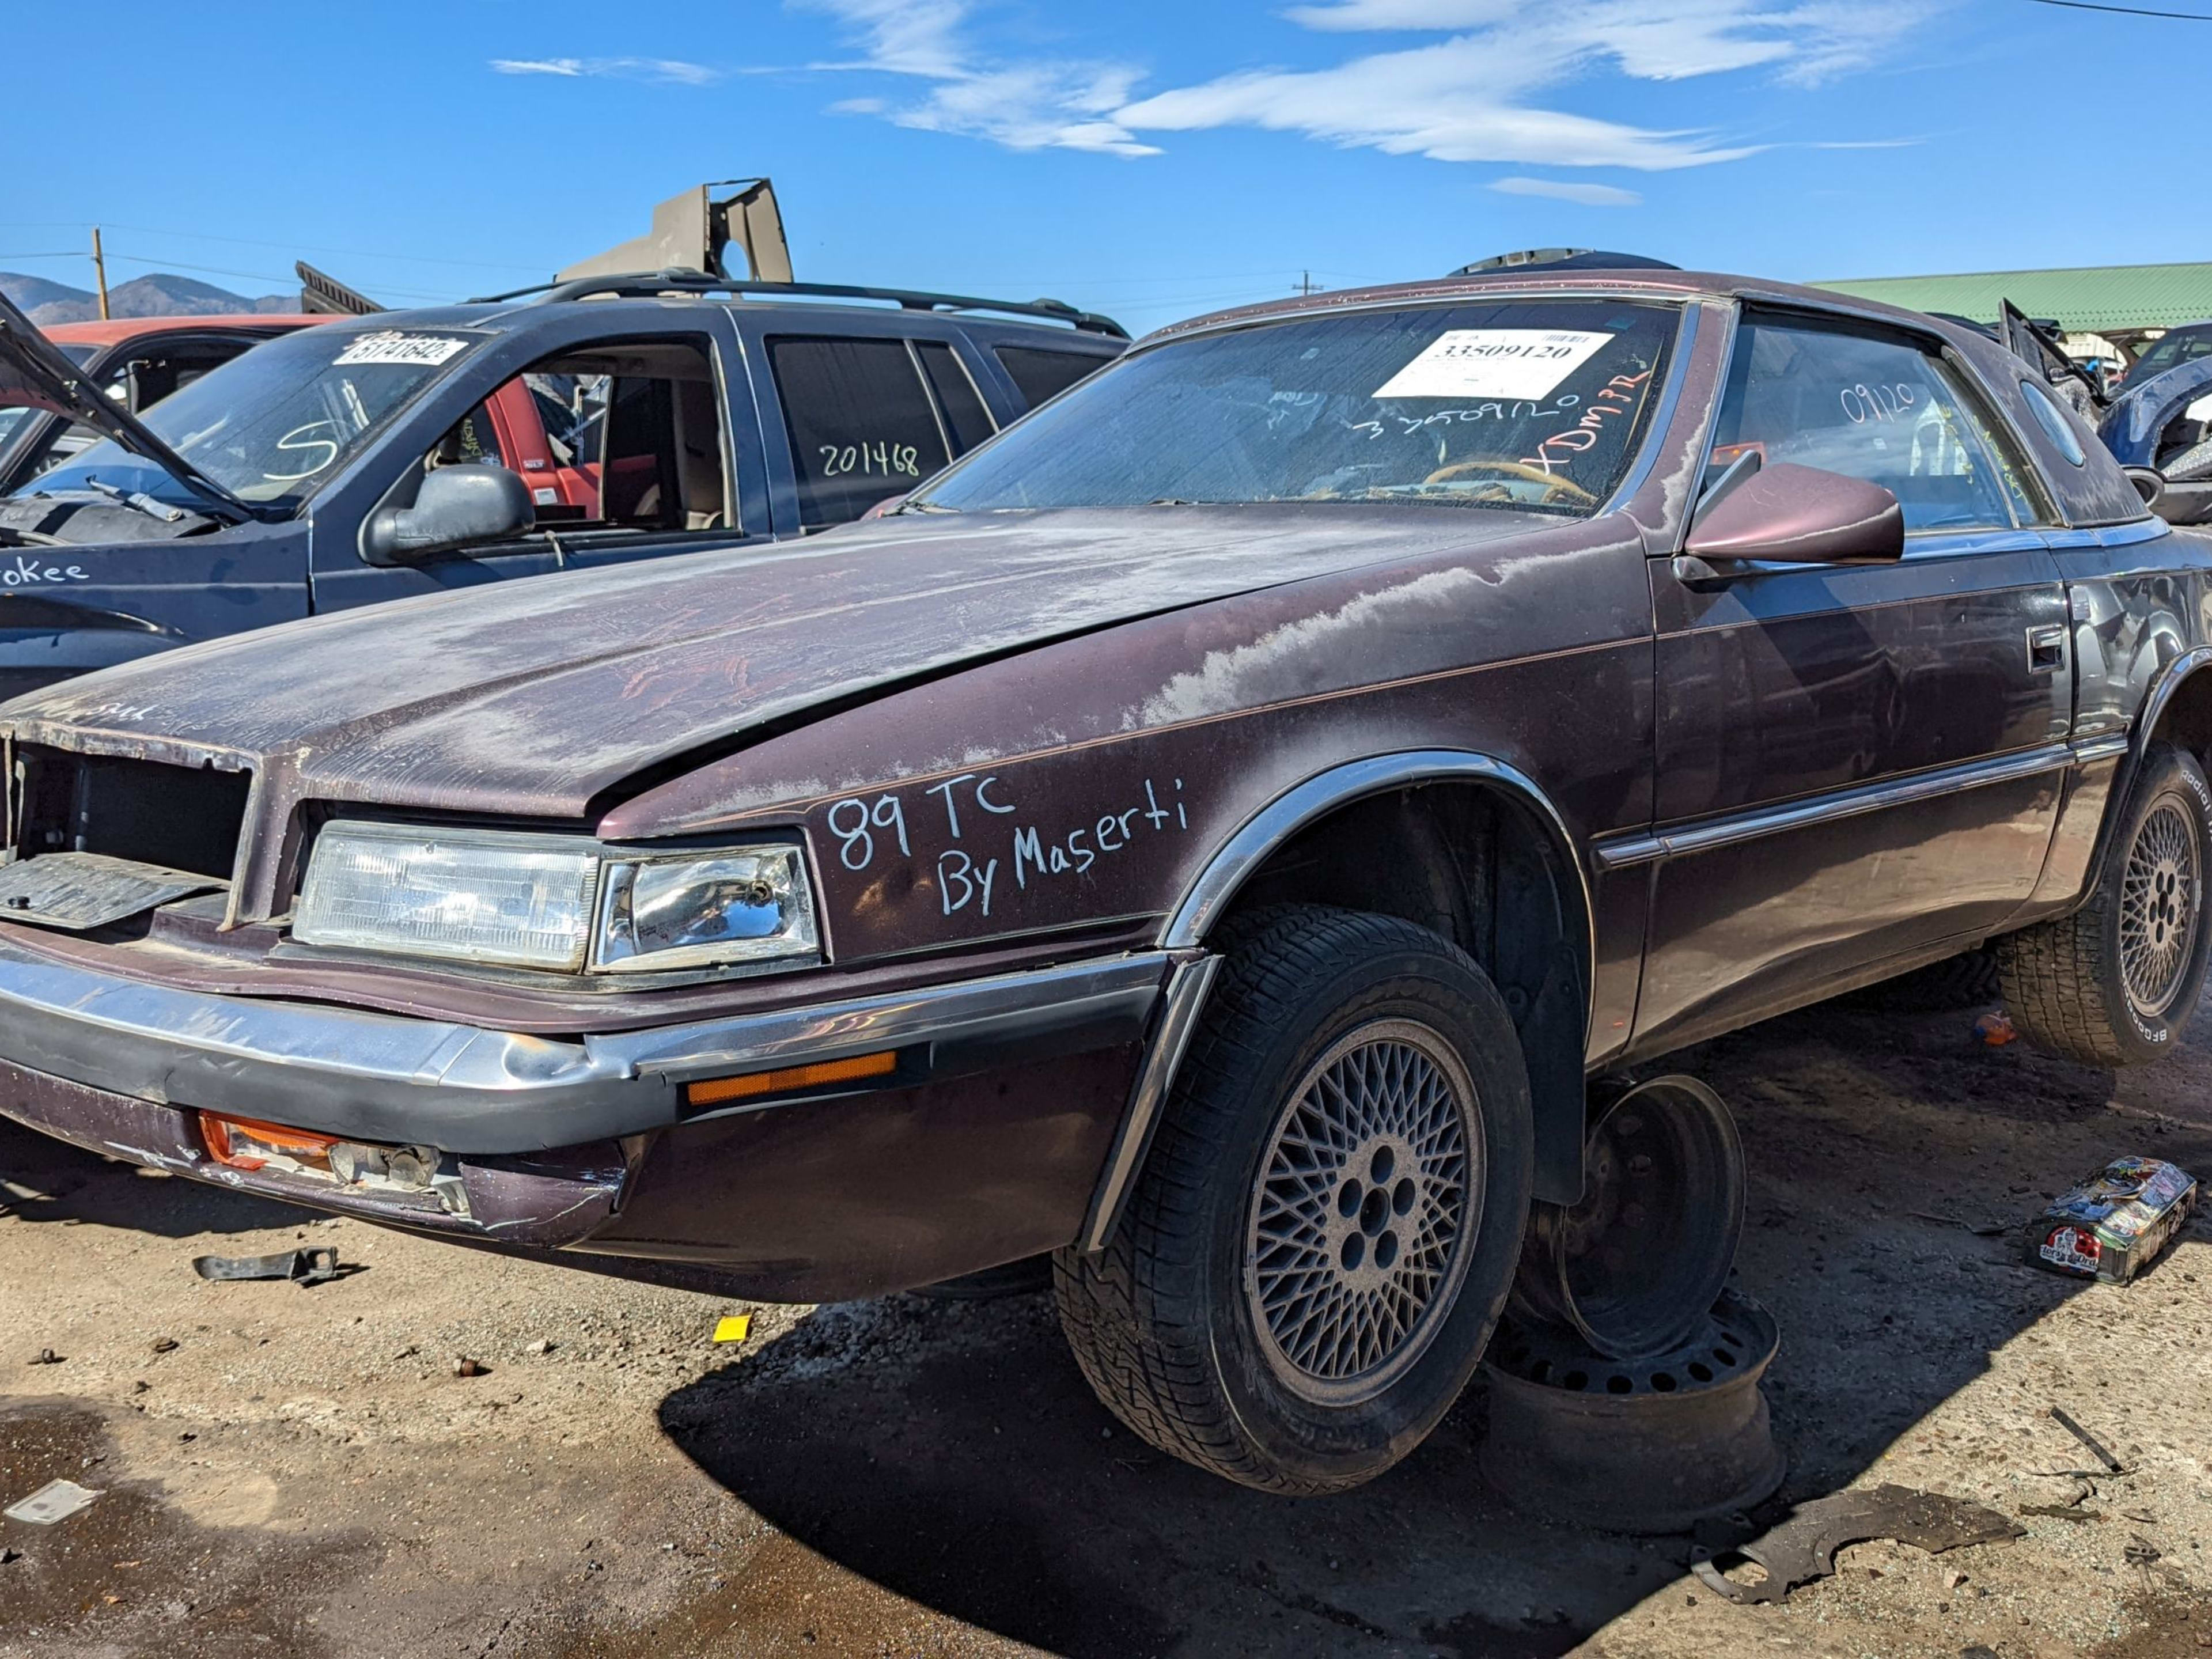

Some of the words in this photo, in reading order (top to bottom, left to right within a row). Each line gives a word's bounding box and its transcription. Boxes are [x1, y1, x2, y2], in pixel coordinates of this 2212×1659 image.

[1435, 344, 1573, 359] 33509120
[1840, 382, 1914, 424] 09120
[819, 441, 920, 478] 201468
[827, 794, 912, 871] 89
[925, 774, 1016, 839] TC
[937, 849, 998, 917] By
[1013, 778, 1188, 891] Maserti
